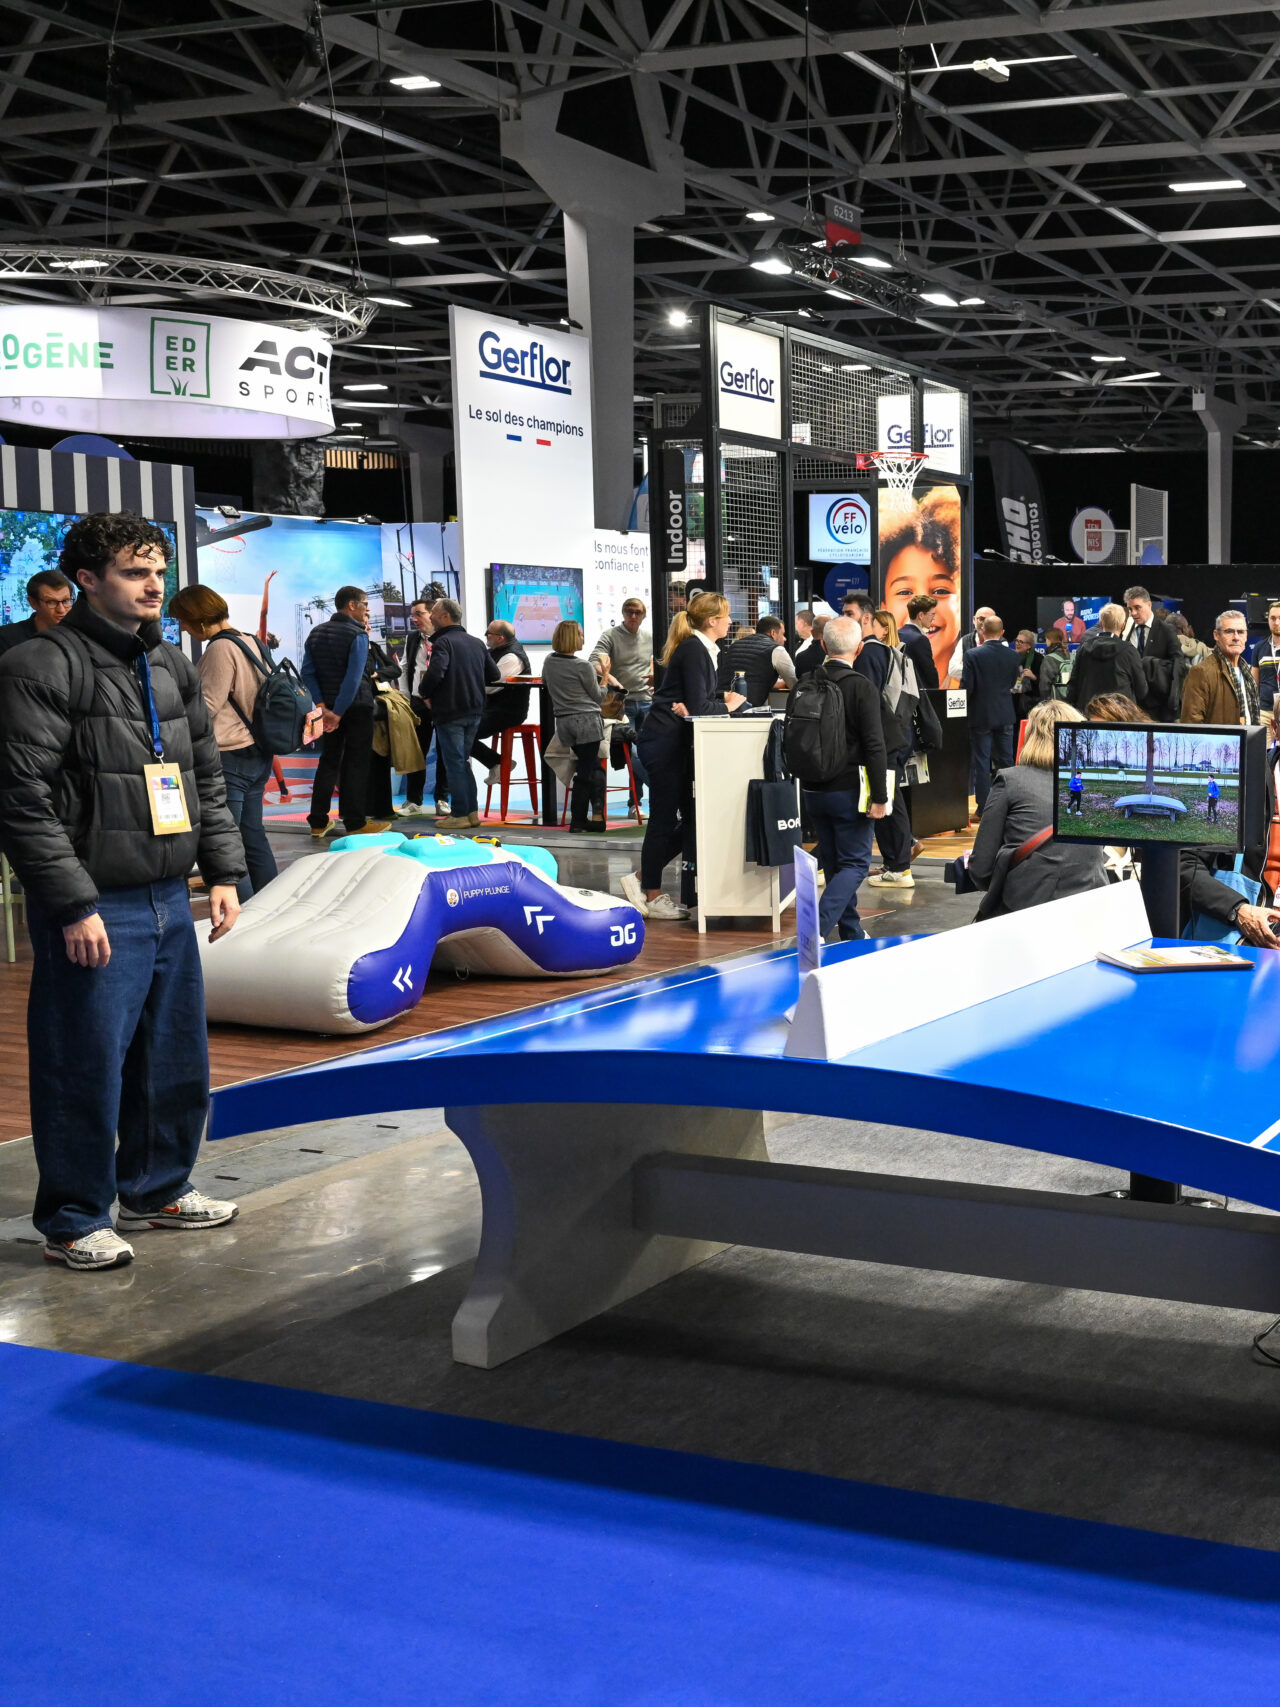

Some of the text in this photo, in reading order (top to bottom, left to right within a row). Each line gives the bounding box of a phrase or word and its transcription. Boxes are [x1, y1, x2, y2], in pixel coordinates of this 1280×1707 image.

[833, 204, 854, 223] 6213
[166, 336, 196, 352] ED
[166, 356, 196, 372] ER
[479, 331, 571, 385] Gerflor
[720, 361, 775, 397] Gerflor
[469, 405, 584, 437] Le sol des champions
[887, 424, 954, 446] Geflor
[844, 512, 856, 523] FF
[666, 490, 684, 564] Indoor
[833, 522, 863, 535] vélo
[605, 544, 628, 555] nous
[630, 544, 649, 557] font
[463, 885, 510, 899] PUPPY PLUNGE
